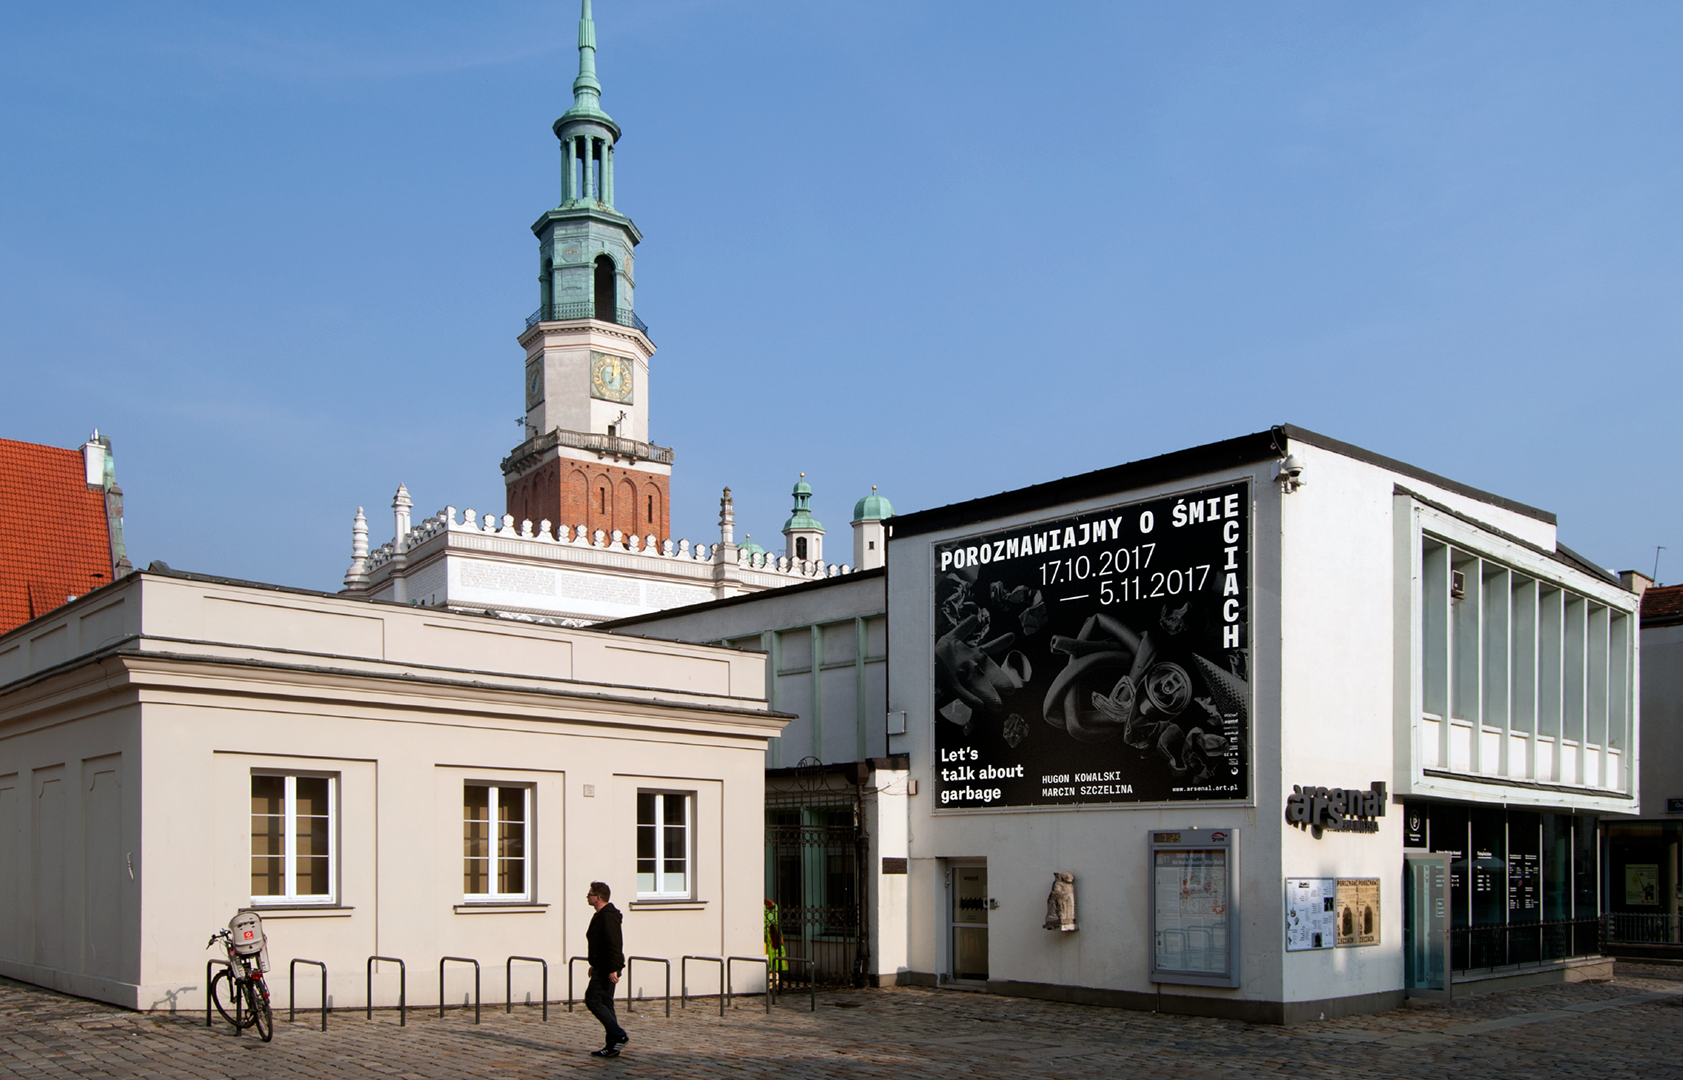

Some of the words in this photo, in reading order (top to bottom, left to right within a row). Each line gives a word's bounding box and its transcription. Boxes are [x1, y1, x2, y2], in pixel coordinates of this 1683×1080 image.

[941, 517, 1123, 572] POROZMAWIAJMY
[1140, 510, 1155, 534] O
[1039, 542, 1156, 586] 17.10.2017
[1099, 564, 1211, 606] 5.11.2017
[941, 747, 979, 762] Let's
[941, 764, 977, 782] talk
[978, 763, 1024, 780] about
[1042, 774, 1070, 784] HUGON
[1074, 771, 1121, 783] KOWALSKI
[940, 786, 1002, 804] garbage
[1042, 787, 1076, 797] MARCIN
[1080, 784, 1133, 796] SZCZELINA
[1172, 784, 1239, 793] www.arsenal.art.pl
